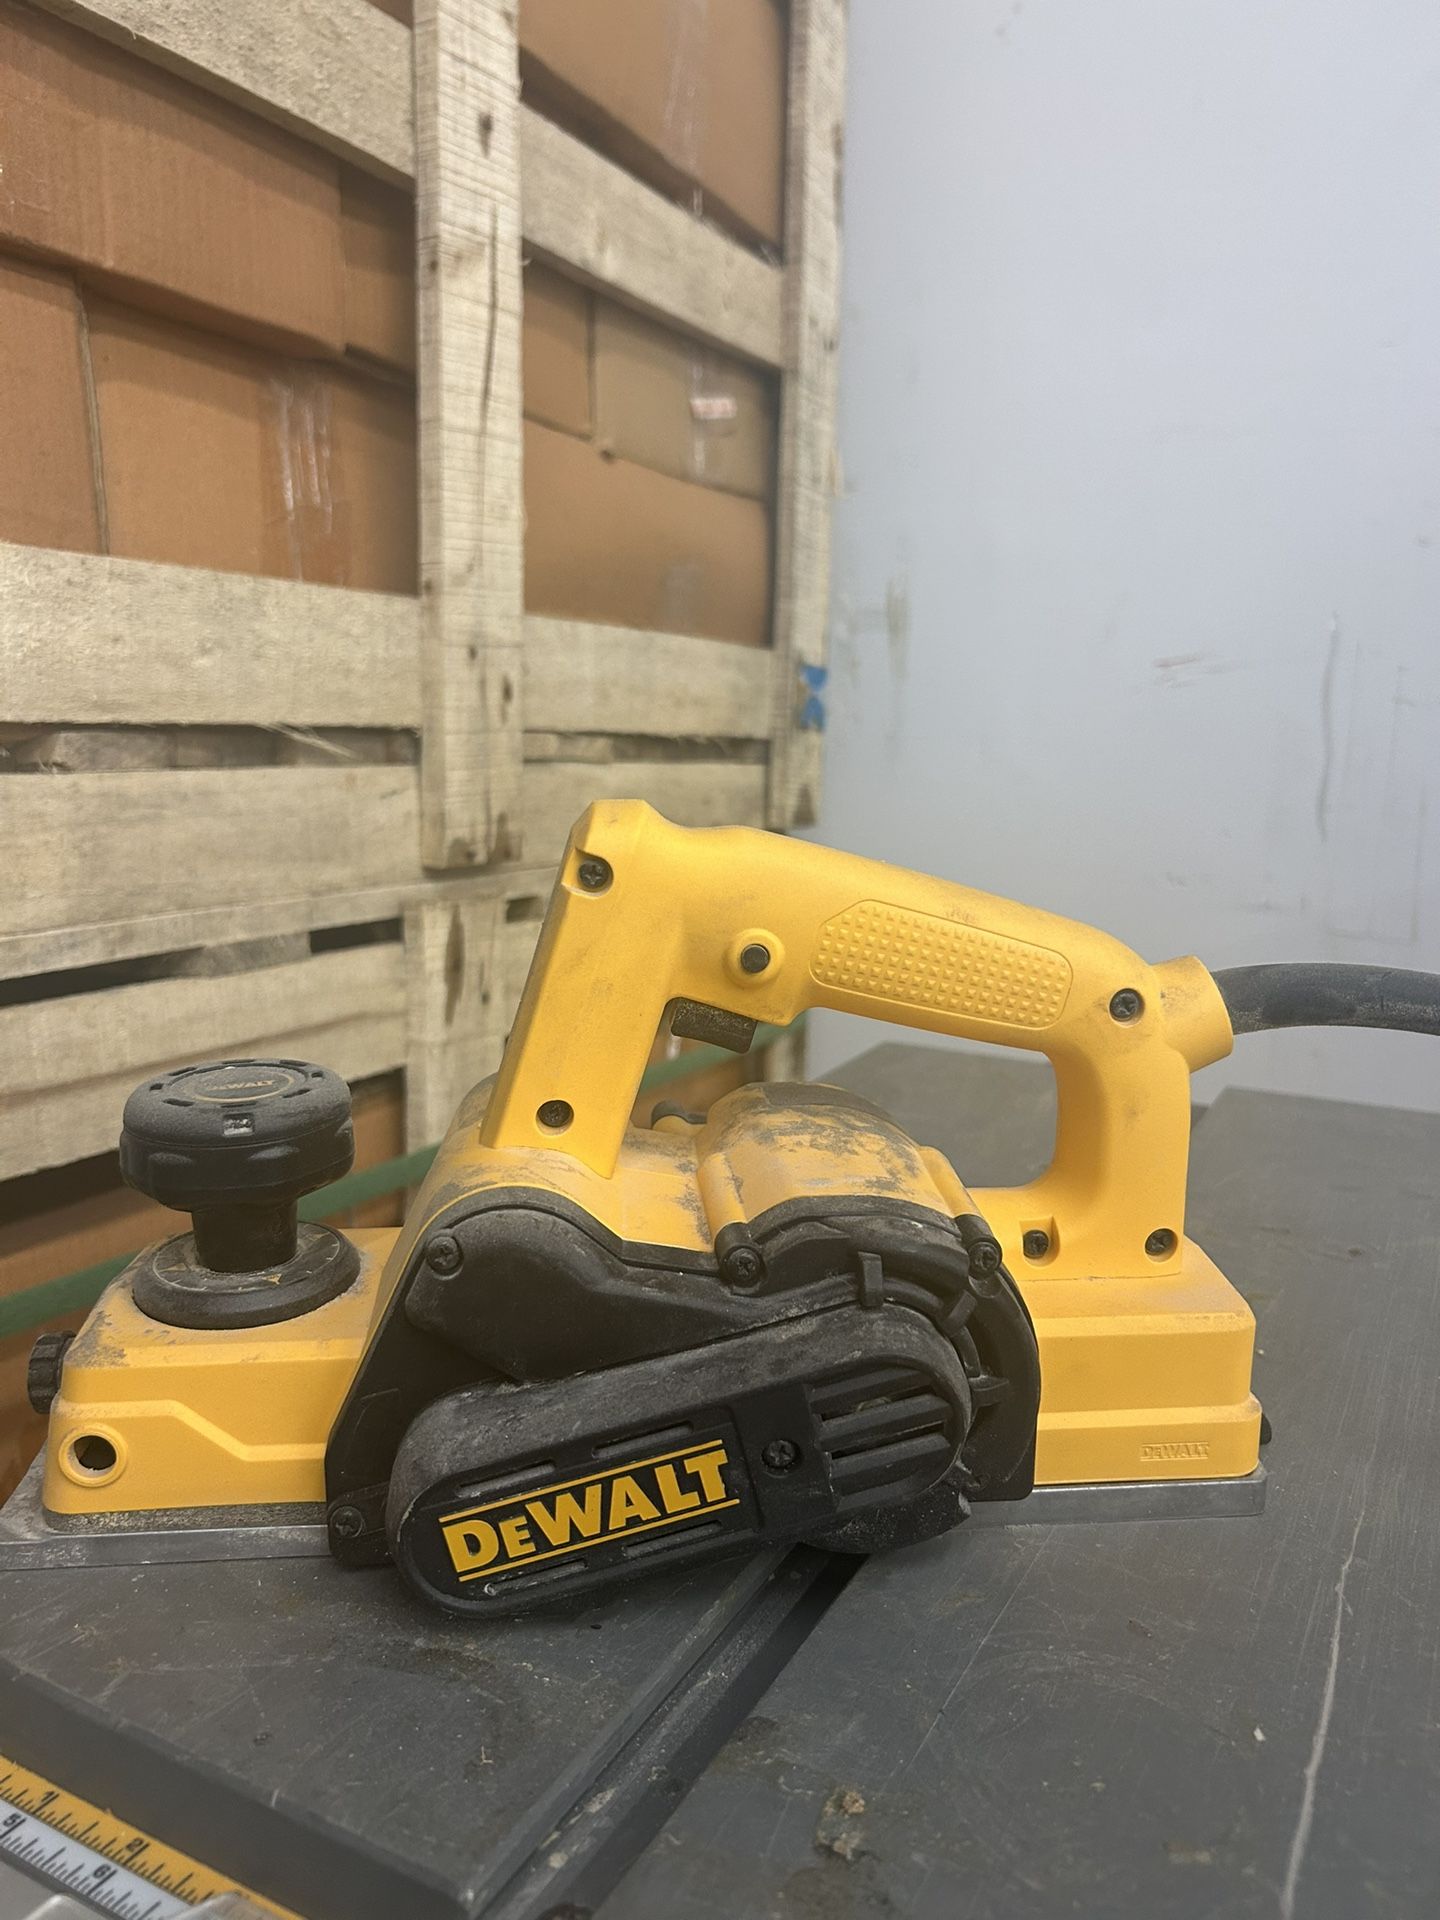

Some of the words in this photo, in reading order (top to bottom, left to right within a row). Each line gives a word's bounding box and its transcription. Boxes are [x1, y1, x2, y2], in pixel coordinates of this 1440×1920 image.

[3, 1813, 21, 1827] 5
[93, 1864, 111, 1879] 6
[126, 1838, 144, 1852] 2
